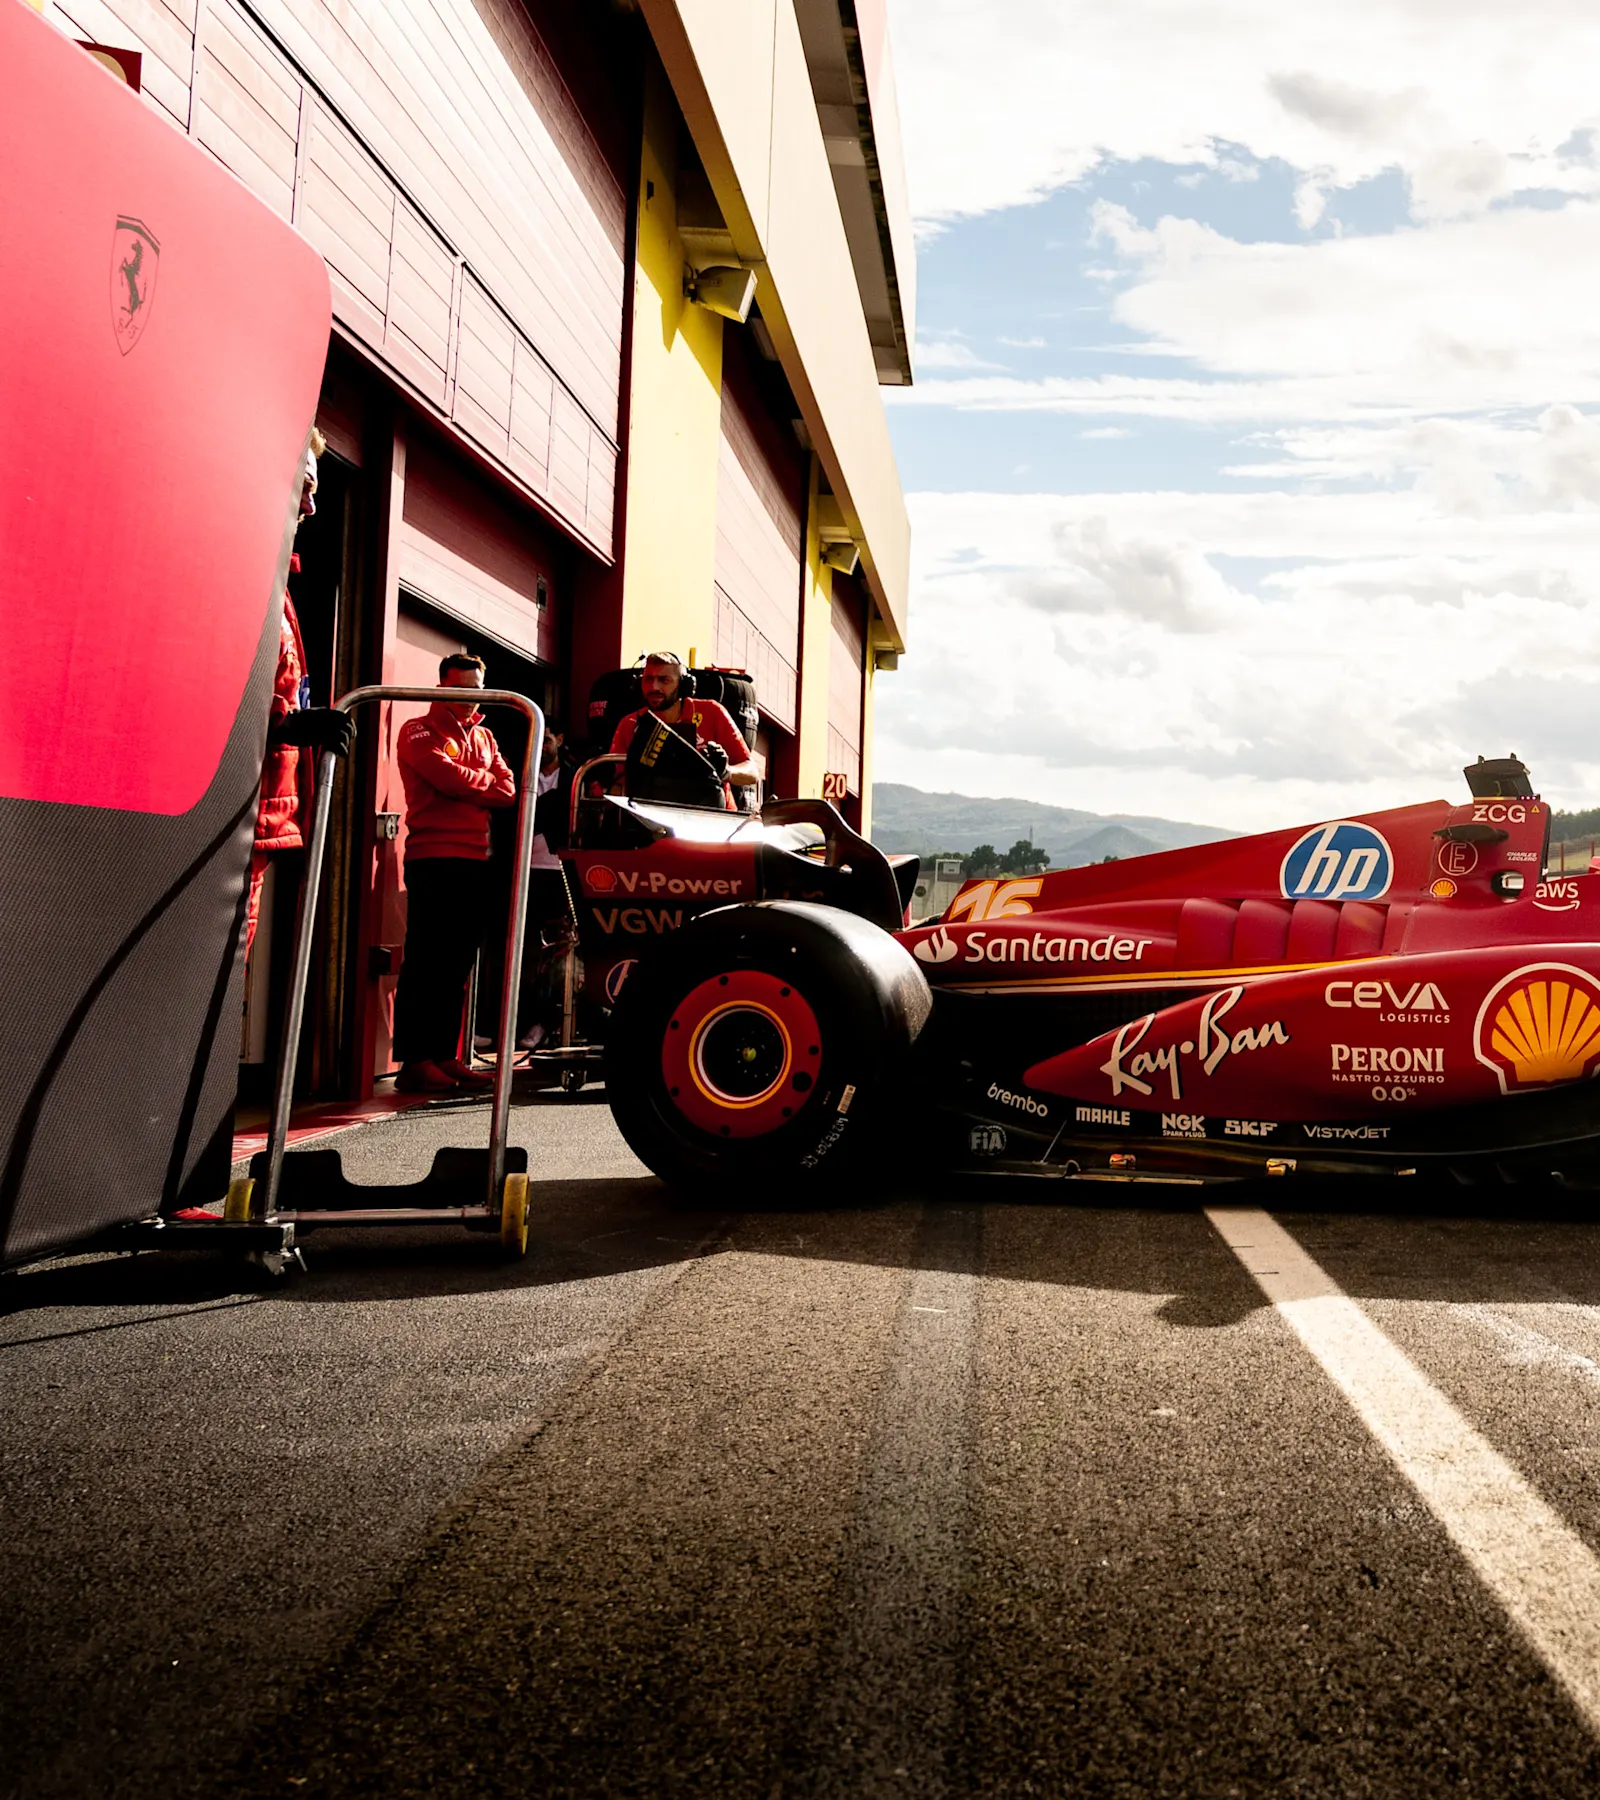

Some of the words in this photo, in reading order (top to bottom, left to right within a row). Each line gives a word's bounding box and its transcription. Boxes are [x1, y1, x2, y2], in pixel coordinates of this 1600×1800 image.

[824, 773, 847, 798] 20
[1472, 804, 1526, 823] ZCG
[1293, 822, 1382, 899] hp
[617, 871, 742, 895] V-Power
[1535, 882, 1580, 900] aws
[948, 878, 1044, 923] 16
[592, 908, 683, 934] VGW
[965, 932, 1153, 962] Santander
[1380, 1013, 1450, 1024] LOGISTICS
[1331, 1044, 1445, 1073] PERONI
[1332, 1073, 1381, 1083] NASTRO
[1384, 1075, 1445, 1084] AZZURRO
[987, 1082, 1048, 1117] brembo
[1076, 1106, 1131, 1126] MAHLE
[1162, 1113, 1205, 1132] NGK
[1224, 1120, 1278, 1136] SKF
